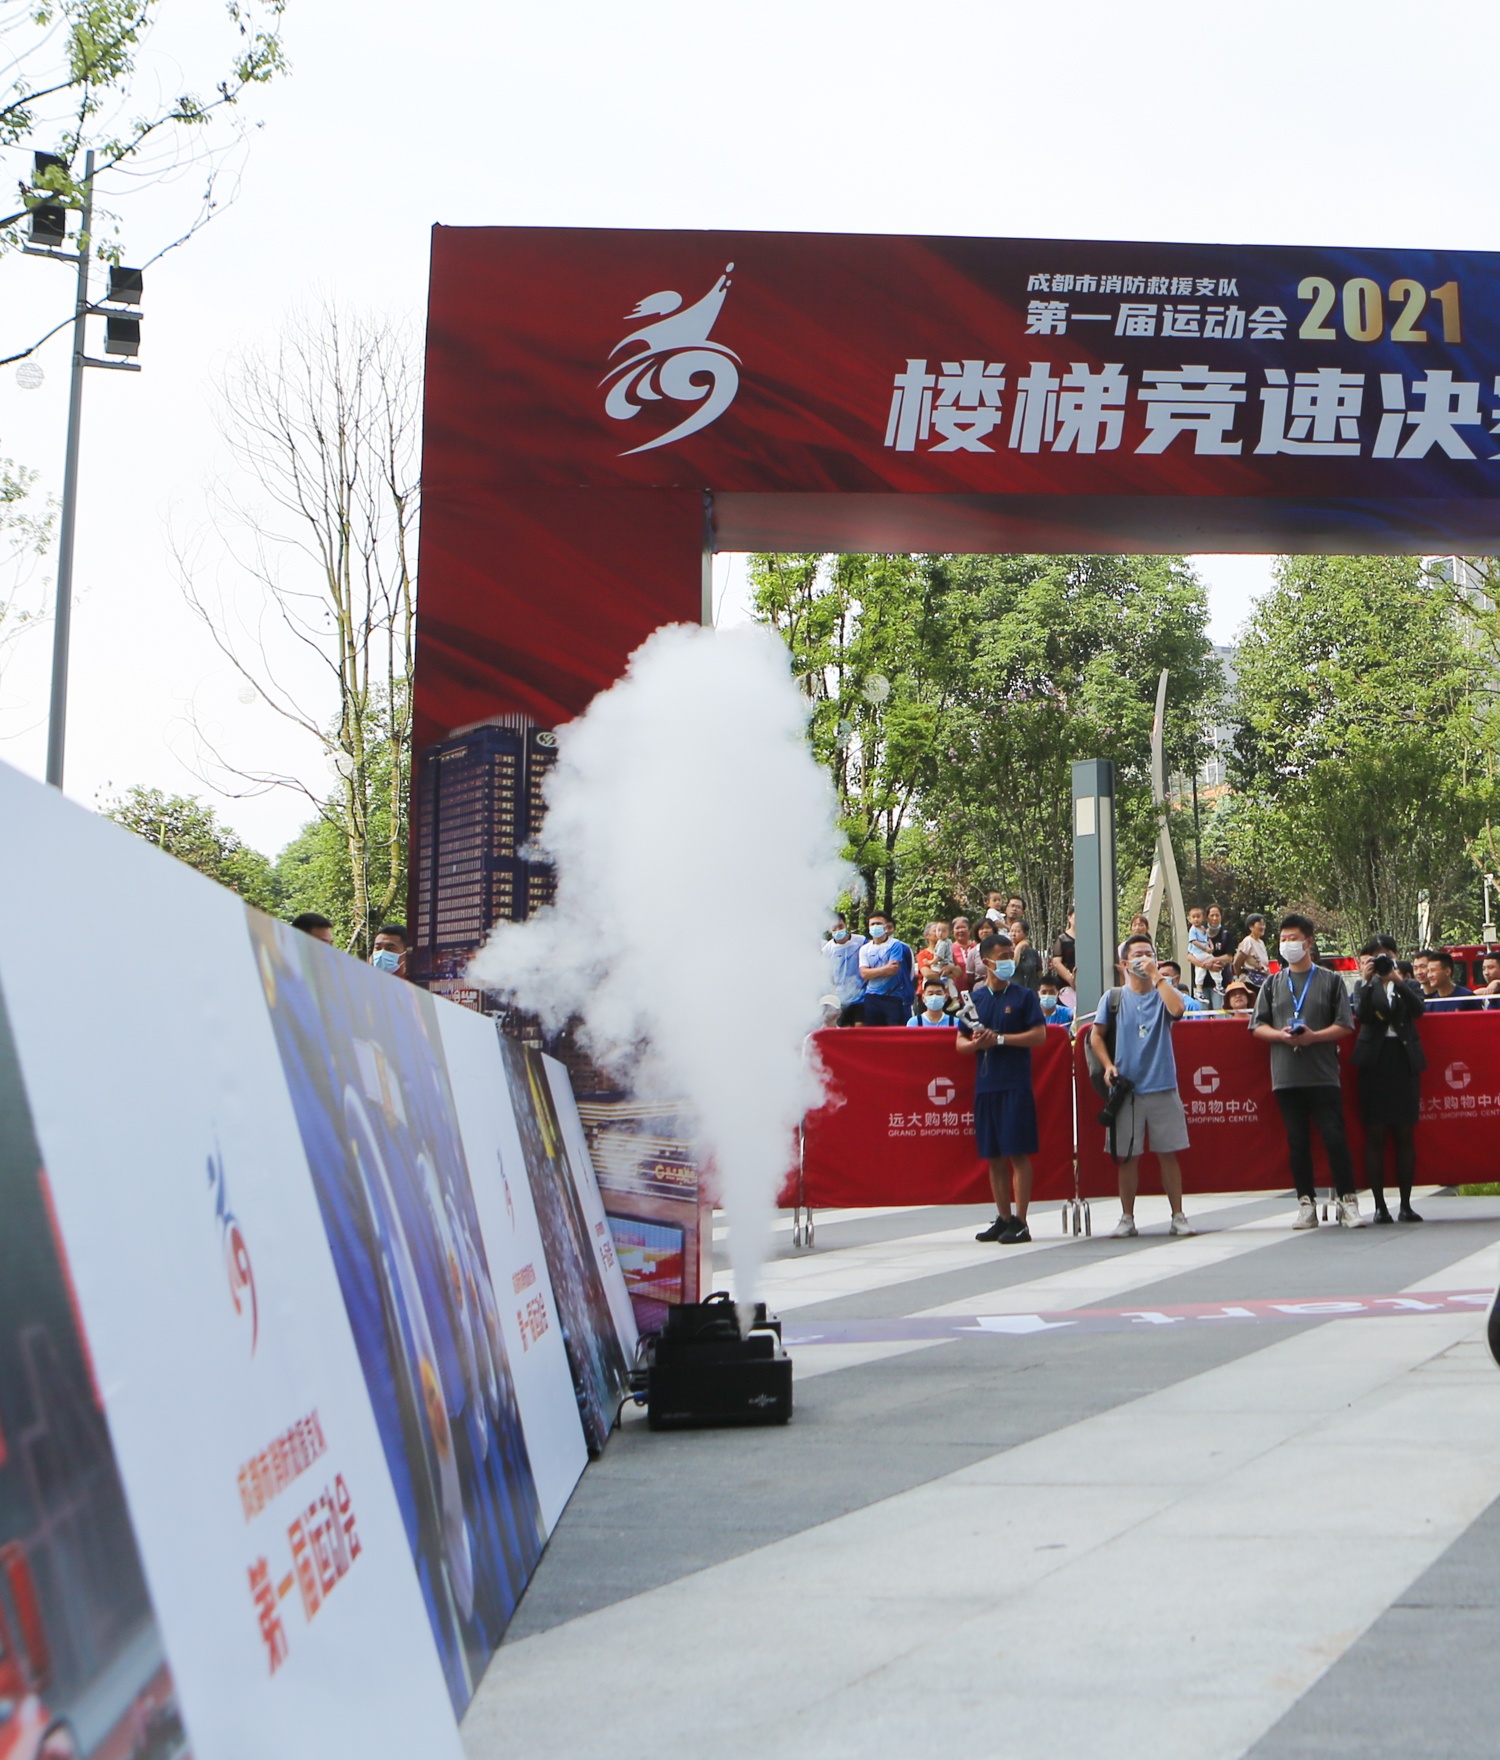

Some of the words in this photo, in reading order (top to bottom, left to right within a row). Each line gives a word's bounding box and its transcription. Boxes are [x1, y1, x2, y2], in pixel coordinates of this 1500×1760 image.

[1027, 273, 1239, 298] 成都市消防救援支队
[1297, 276, 1463, 343] 2021
[1024, 300, 1288, 341] 第一届运动会
[1182, 1098, 1258, 1115] 购物中心
[888, 1112, 975, 1127] 远大购物中
[1187, 1115, 1225, 1124] SHOPPING
[1229, 1114, 1258, 1123] CENTER
[888, 1129, 917, 1137] GRAND
[920, 1128, 960, 1137] SHOPPING
